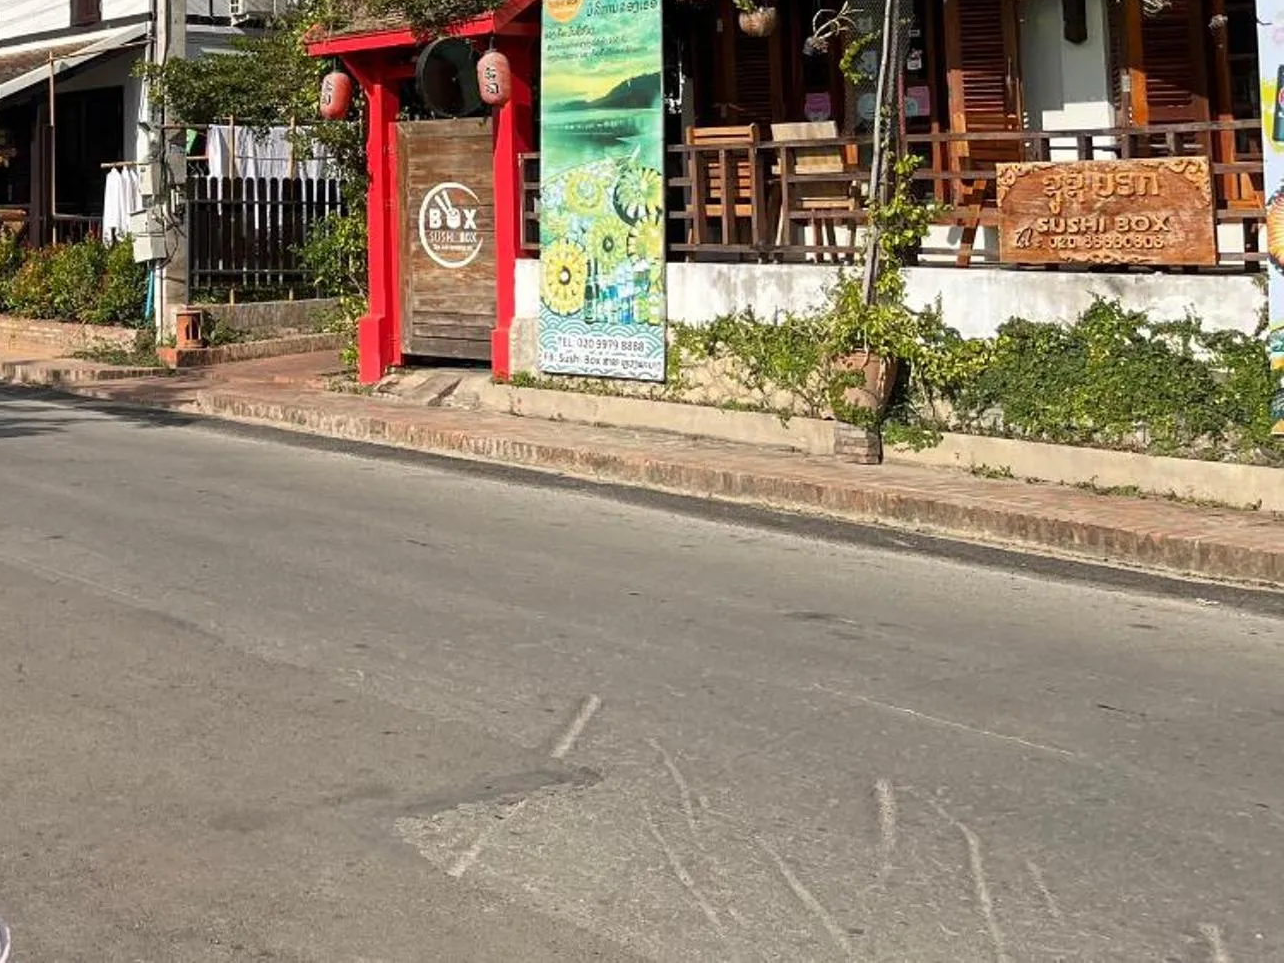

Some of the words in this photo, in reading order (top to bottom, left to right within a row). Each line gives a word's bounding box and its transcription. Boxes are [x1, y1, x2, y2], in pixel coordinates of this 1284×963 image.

[429, 208, 477, 230] BOX
[1036, 216, 1106, 234] SUSHI
[1114, 215, 1170, 233] BOX
[577, 337, 594, 349] 020
